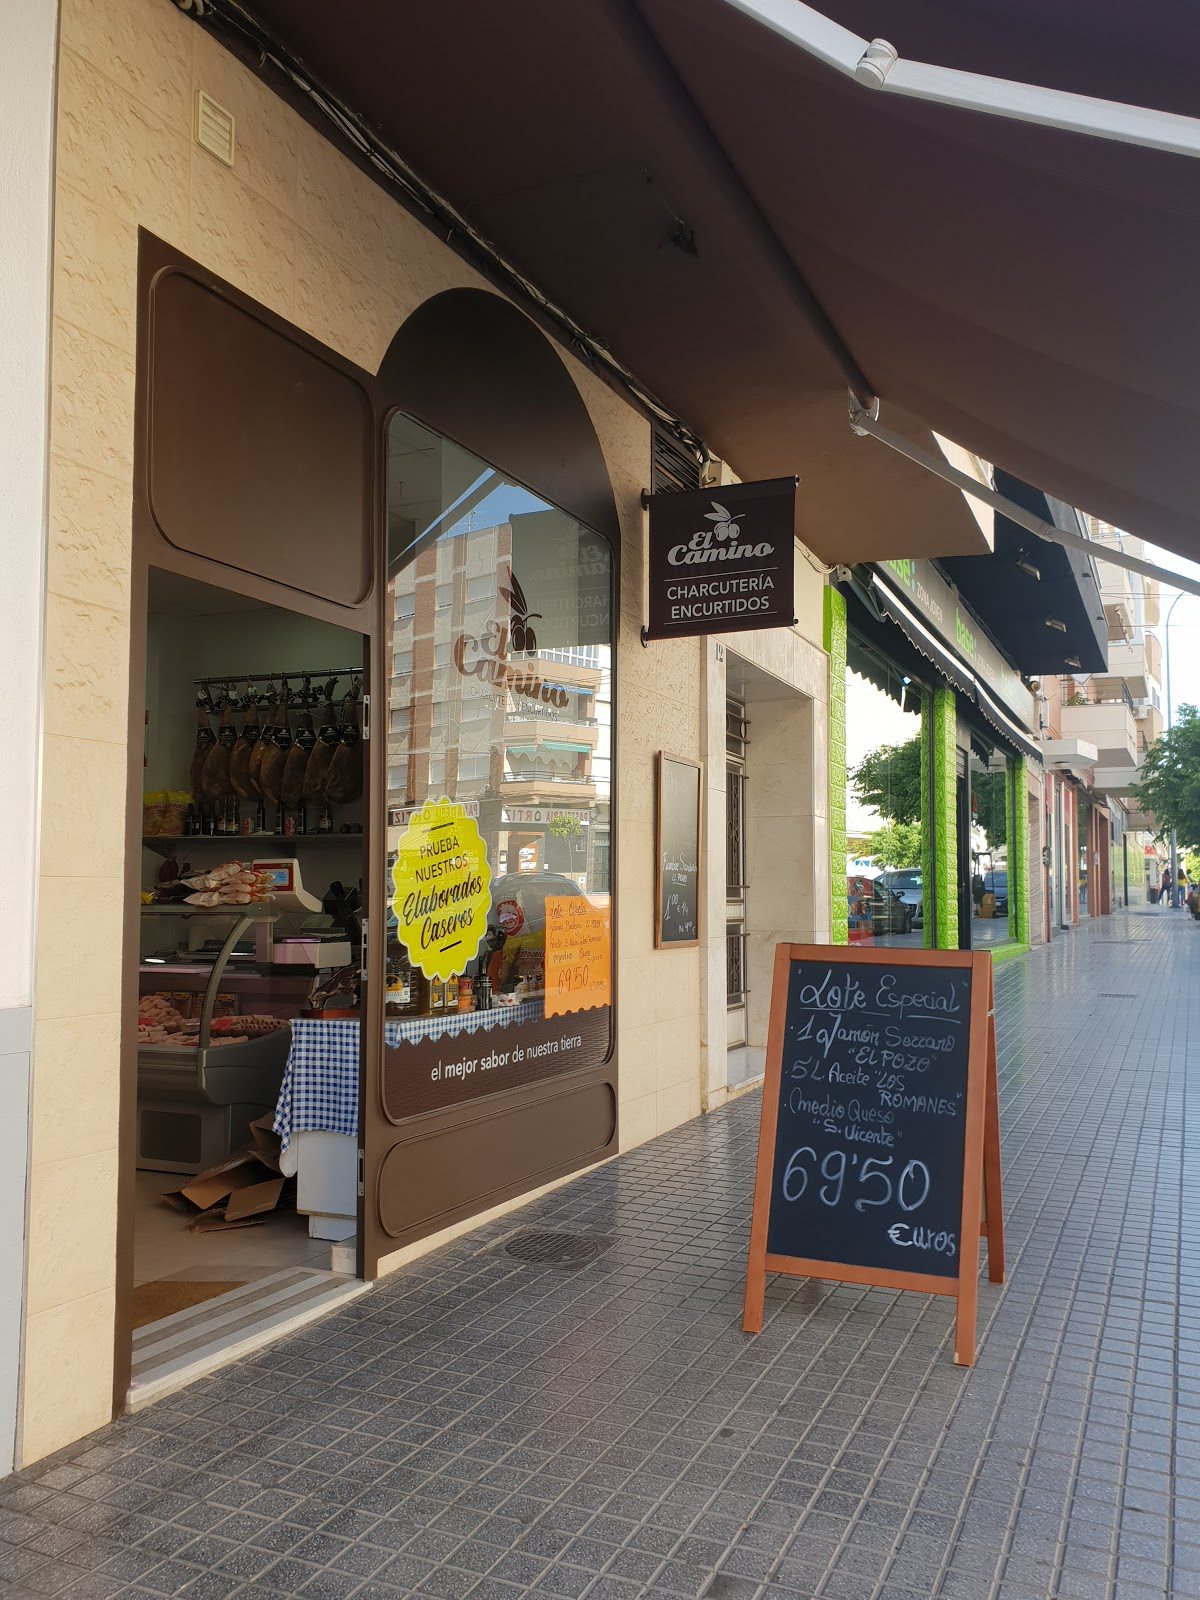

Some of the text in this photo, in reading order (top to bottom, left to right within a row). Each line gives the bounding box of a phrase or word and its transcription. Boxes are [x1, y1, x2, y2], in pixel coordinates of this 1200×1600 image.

[667, 541, 775, 566] Camino
[688, 531, 714, 550] El
[666, 573, 775, 600] CHARCUTERÍA
[671, 595, 769, 619] ENCURTIDOS
[454, 633, 569, 709] Camino
[419, 835, 460, 860] PRUEBA
[415, 853, 469, 885] NUESTROS
[402, 871, 484, 927] Elaborados
[420, 907, 475, 950] Caseros
[876, 974, 960, 1019] Especial
[431, 1034, 582, 1081] el mejor sabor de nuestra tierra
[829, 1062, 870, 1085] Aceite
[847, 1099, 894, 1123] Queso
